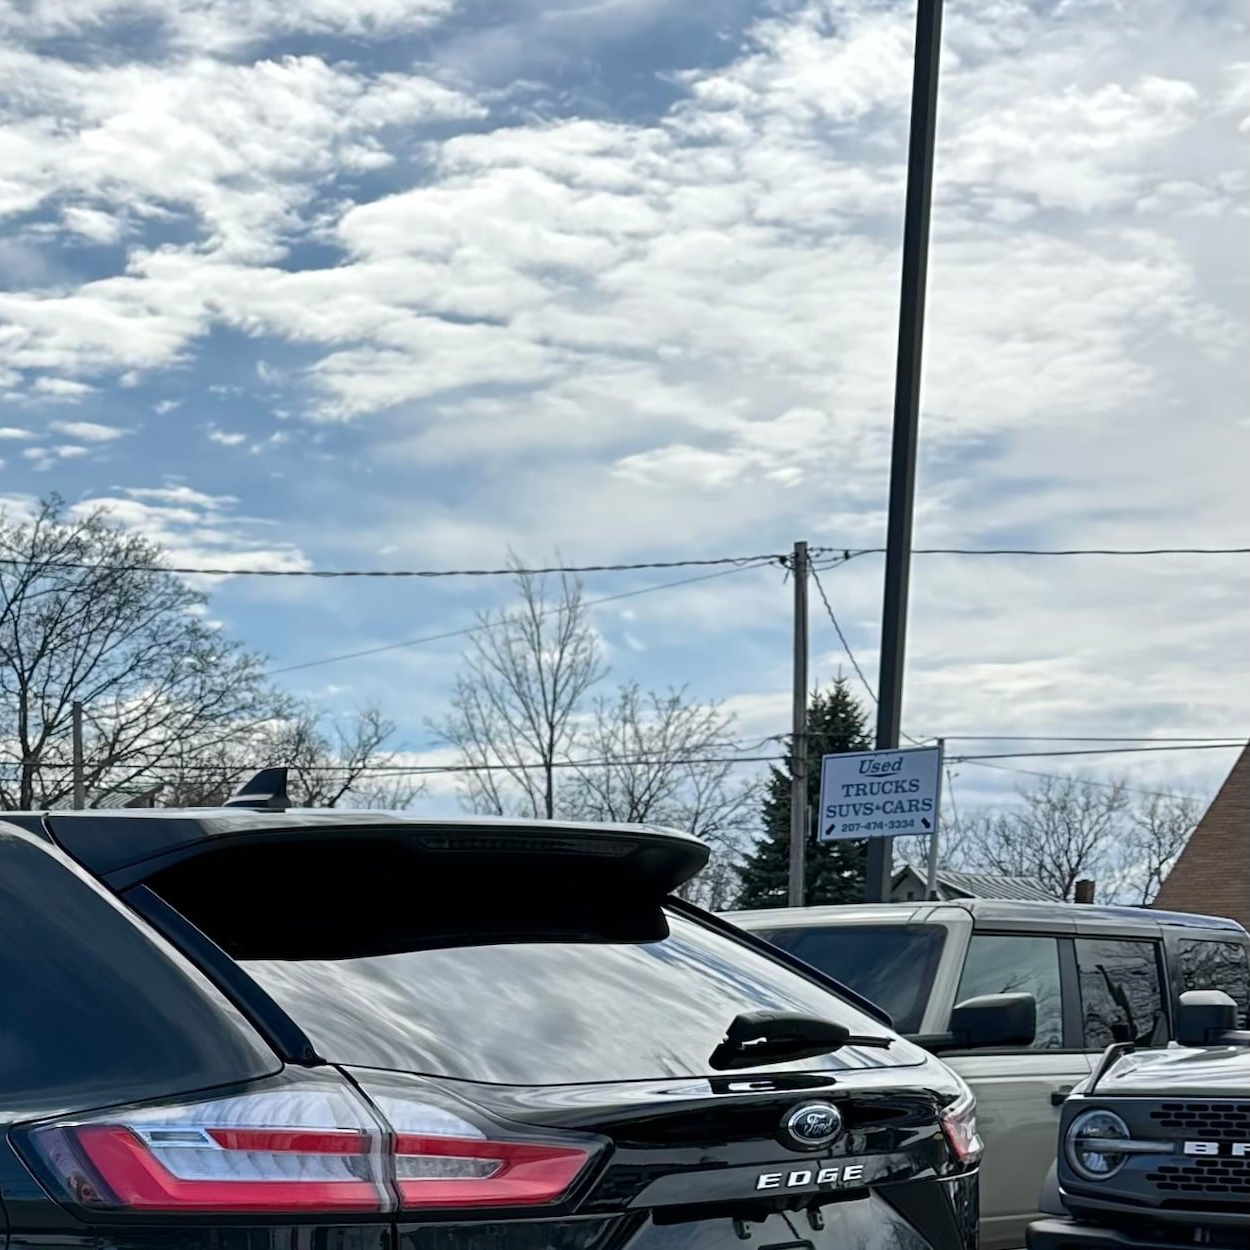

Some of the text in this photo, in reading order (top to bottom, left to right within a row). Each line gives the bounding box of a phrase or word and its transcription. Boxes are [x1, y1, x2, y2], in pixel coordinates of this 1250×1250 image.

[859, 757, 903, 774] Used
[842, 779, 920, 797] TRUCKS
[756, 1165, 864, 1190] EDGE
